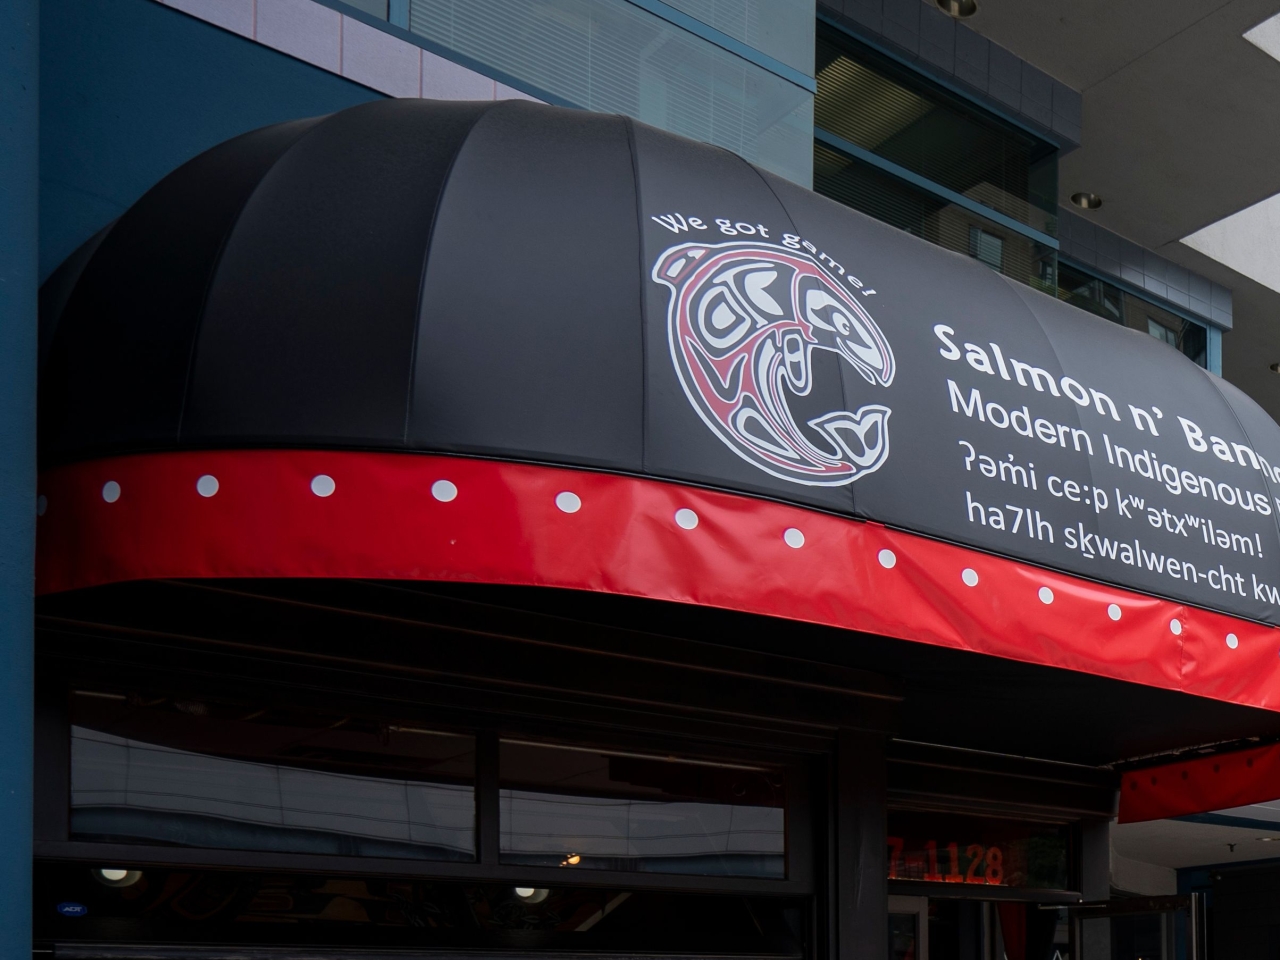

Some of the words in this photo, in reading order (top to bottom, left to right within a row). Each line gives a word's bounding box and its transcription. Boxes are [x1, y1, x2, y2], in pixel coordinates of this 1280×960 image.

[651, 213, 707, 233] We
[715, 217, 770, 239] got
[781, 232, 877, 297] game!
[933, 324, 1121, 421] Salmon
[947, 378, 1094, 456] Modern
[1103, 433, 1271, 516] Indigenous
